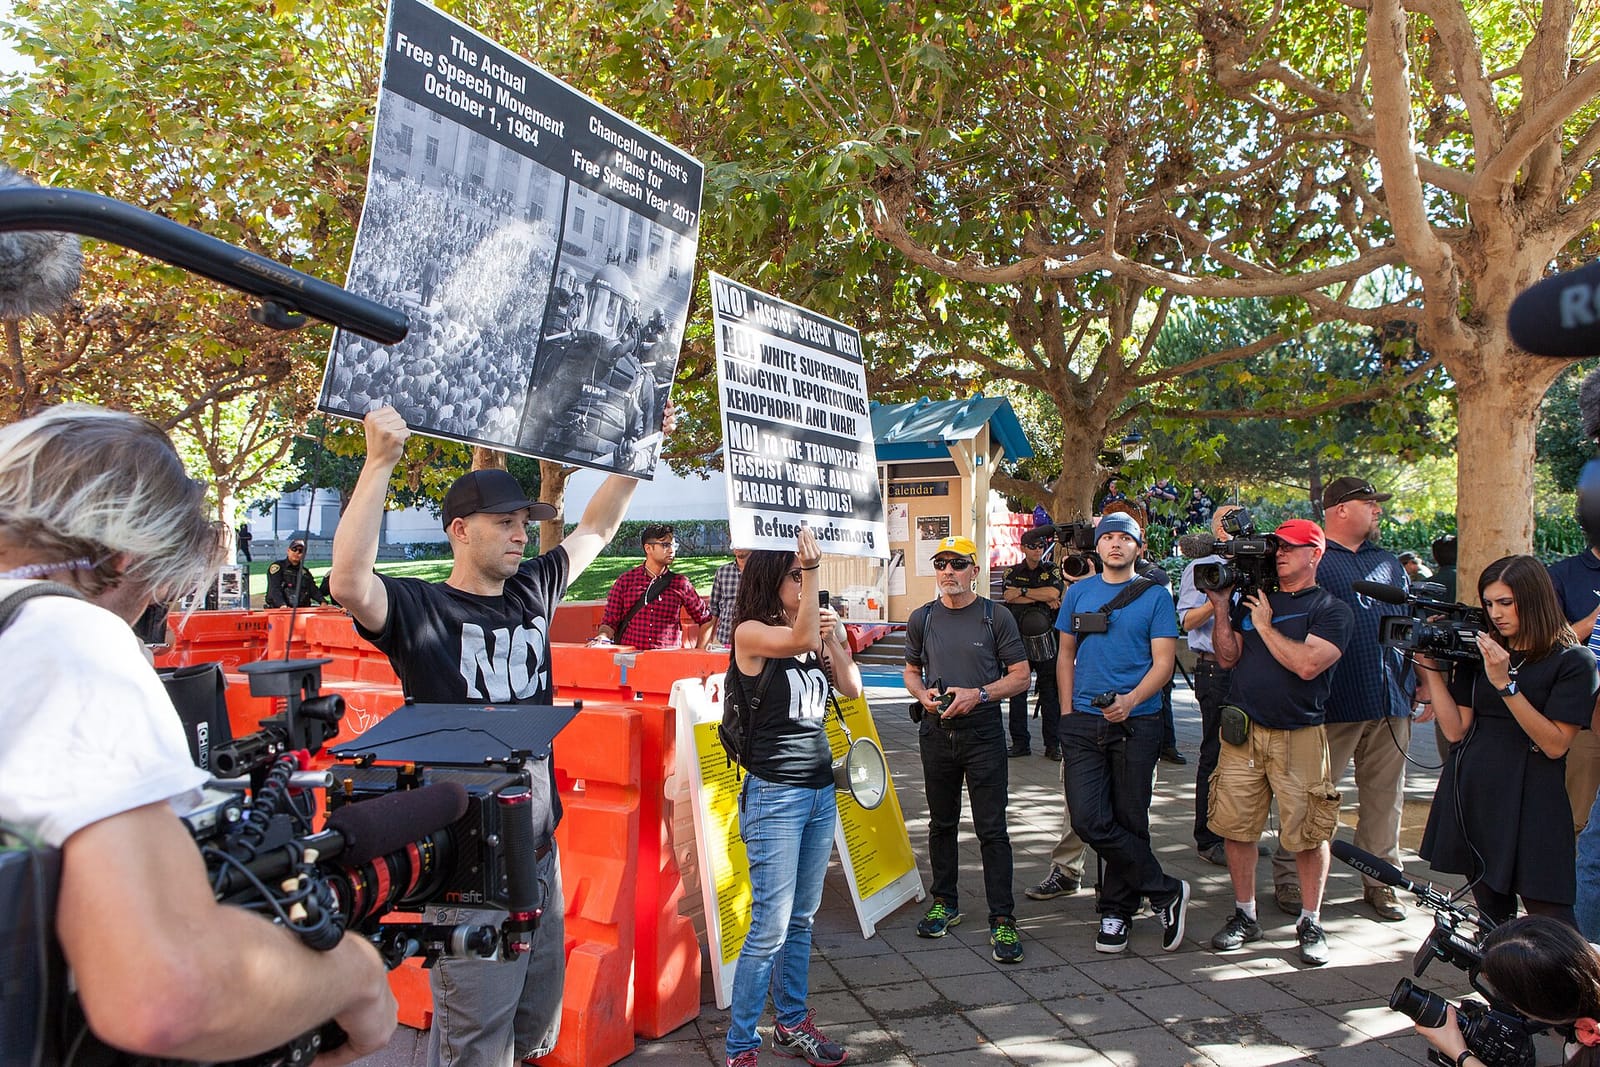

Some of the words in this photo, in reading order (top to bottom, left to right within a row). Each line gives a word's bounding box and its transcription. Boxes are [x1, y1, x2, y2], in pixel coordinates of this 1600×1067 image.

[396, 32, 433, 68] Free
[437, 56, 492, 101] Speech
[496, 87, 565, 139] Movement
[450, 35, 478, 67] The
[481, 56, 526, 95] Actual
[424, 73, 486, 120] October
[489, 106, 502, 131] 1,
[507, 116, 539, 148] 1964
[589, 115, 648, 162] Chancellor
[650, 149, 688, 184] Christ's
[615, 151, 645, 181] Plans
[647, 169, 662, 190] for
[571, 149, 600, 180] 'Free
[602, 167, 643, 203] Speech
[645, 186, 672, 214] Year'
[672, 203, 696, 228] 2017
[715, 280, 748, 319] NO!
[753, 300, 792, 335] FASCIST
[792, 315, 832, 348] "SPEECH"
[833, 329, 859, 358] WEEK!
[1561, 284, 1600, 329] R
[722, 324, 755, 360] NO!
[760, 343, 797, 373] WHITE
[800, 355, 862, 394] SUPREMACY,
[724, 359, 791, 397] MISOGYNY,
[793, 377, 869, 418] DEPORTATIONS,
[726, 387, 802, 424] XENOPHOBIA
[805, 406, 827, 430] AND
[829, 411, 857, 437] WAR!
[728, 419, 759, 452] NO!
[762, 434, 778, 456] TO
[781, 437, 804, 461] THE
[731, 455, 783, 481] FASCIST
[785, 462, 828, 488] REGIME
[829, 470, 851, 490] AND
[851, 473, 870, 493] ITS
[733, 480, 785, 506] PARADE
[787, 486, 801, 508] OF
[804, 489, 854, 514] GHOULS!
[888, 484, 934, 496] Calendar
[446, 890, 482, 904] misfit
